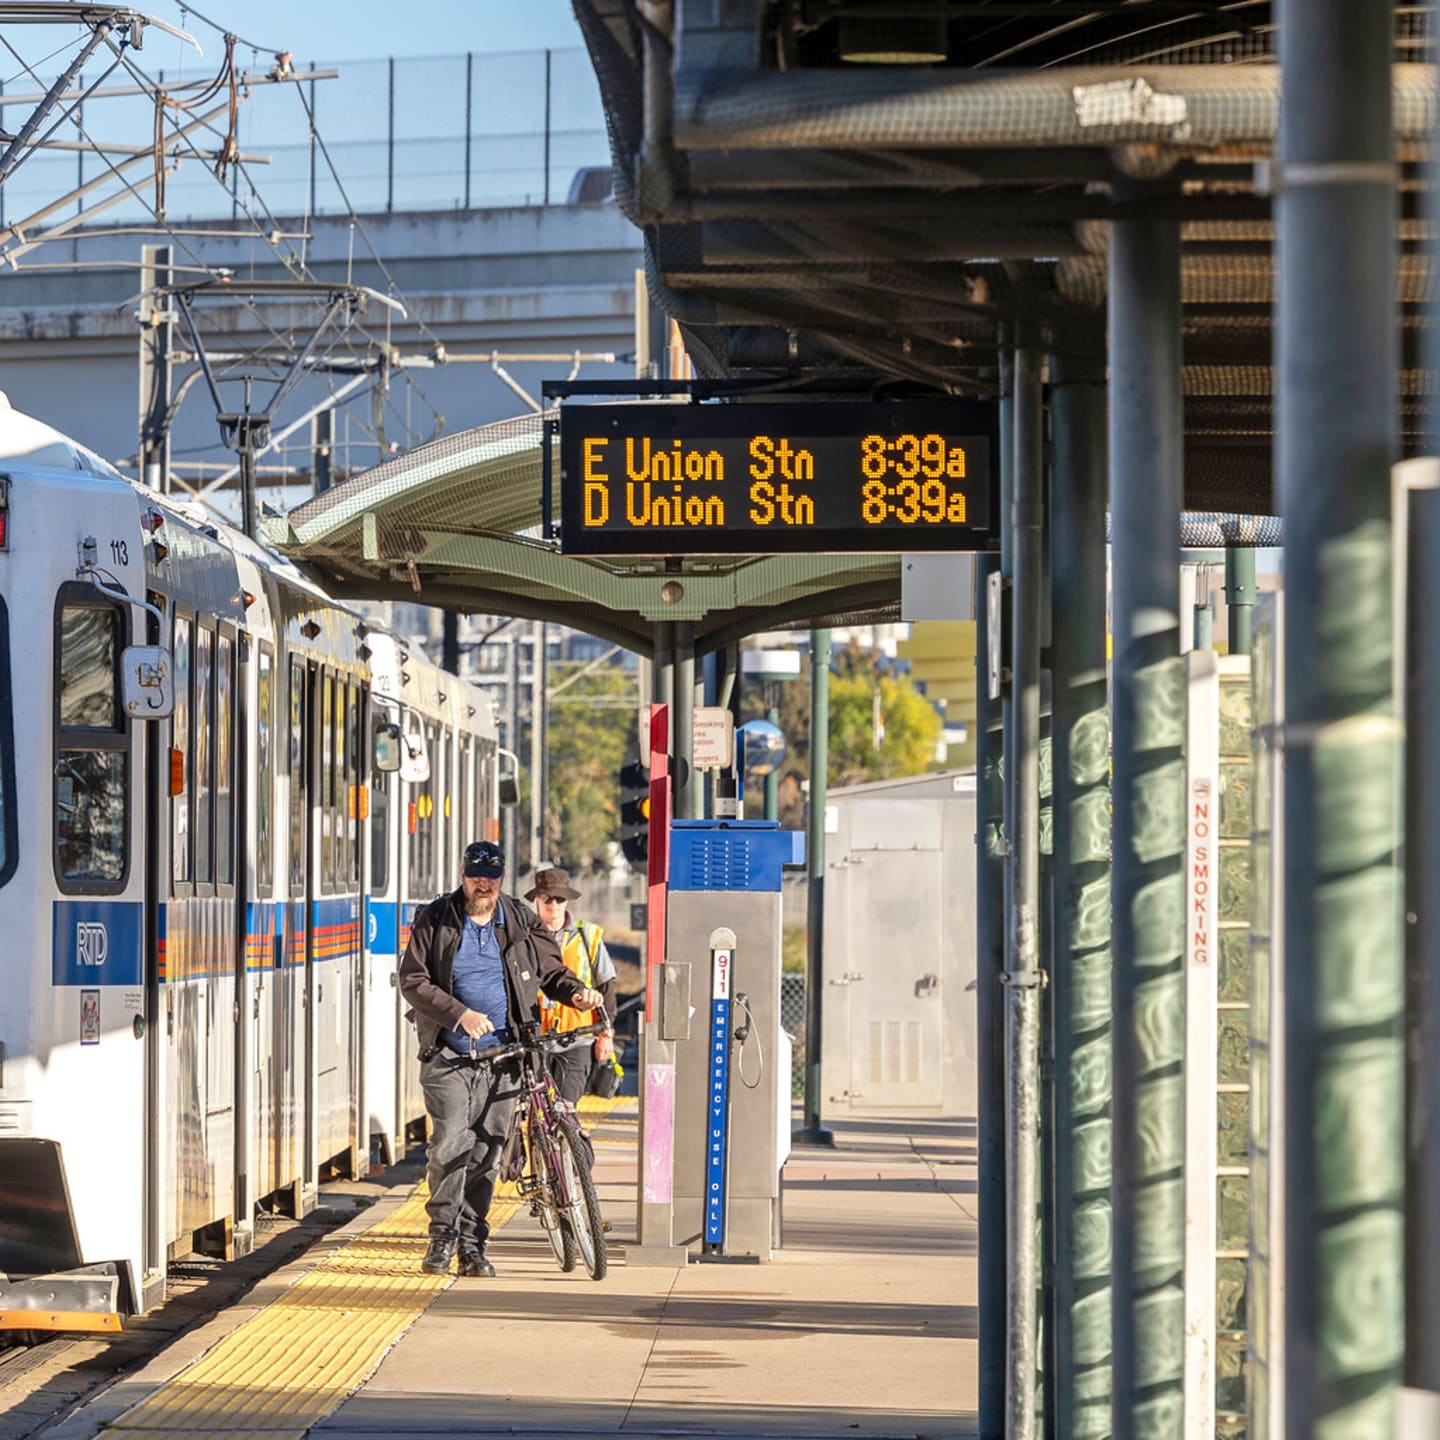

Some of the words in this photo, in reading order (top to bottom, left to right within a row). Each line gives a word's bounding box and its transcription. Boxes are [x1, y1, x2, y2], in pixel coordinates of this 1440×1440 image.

[584, 437, 609, 481] E
[626, 437, 724, 481] Union
[749, 436, 814, 480] Stn
[862, 434, 966, 480] 8:39a
[584, 482, 609, 527] D
[626, 482, 725, 526] Union
[749, 481, 814, 525] Stn
[862, 480, 967, 524] 8:39a
[110, 539, 129, 566] 113
[1193, 803, 1210, 838] NO
[1193, 846, 1209, 963] SMOKING
[76, 921, 108, 966] RTD
[718, 955, 728, 993] 911
[714, 1003, 725, 1116] EMERGENCY
[712, 1129, 721, 1165] USE
[710, 1183, 720, 1235] ONLY
